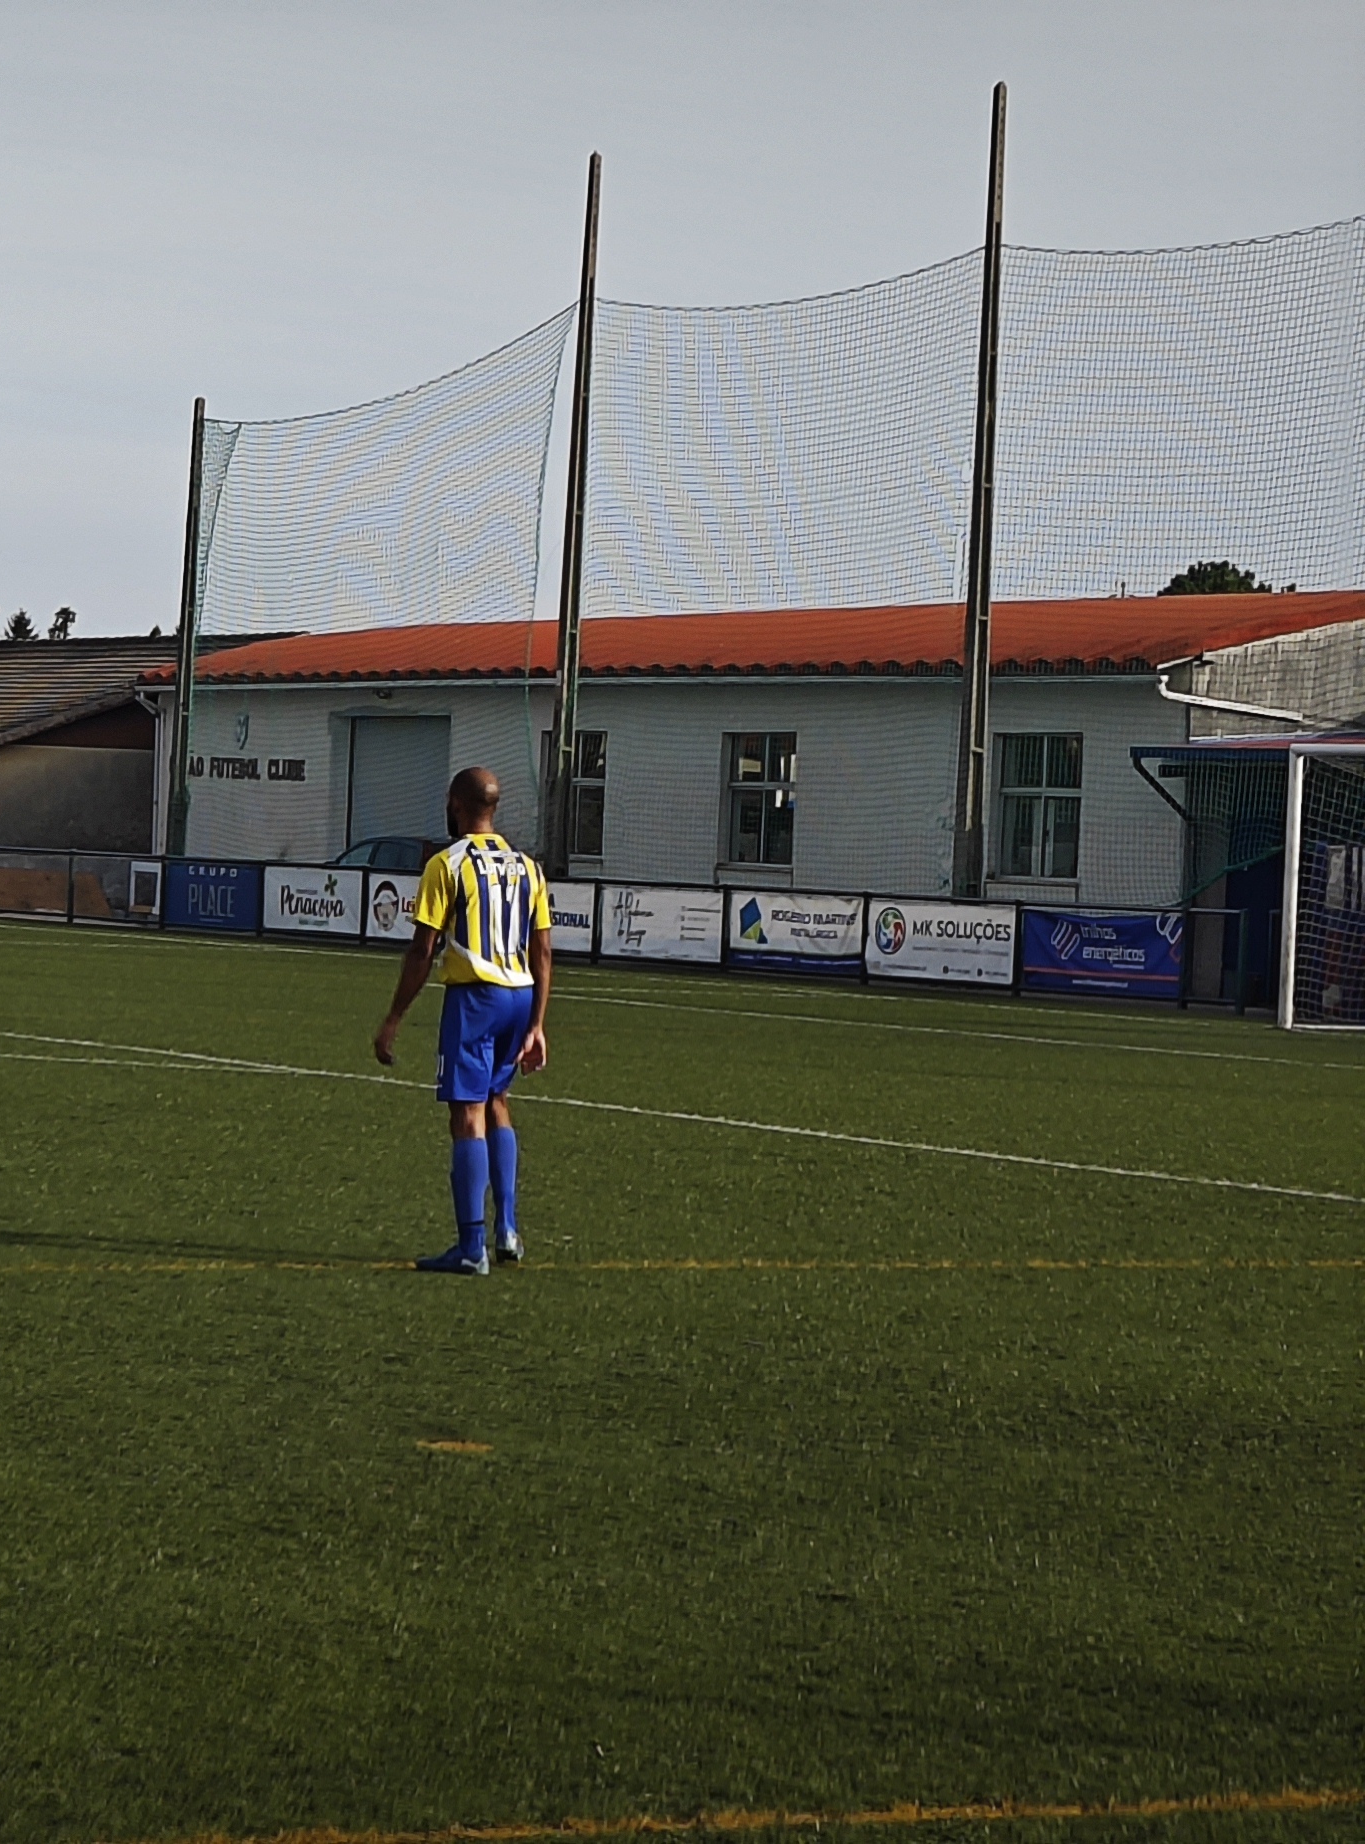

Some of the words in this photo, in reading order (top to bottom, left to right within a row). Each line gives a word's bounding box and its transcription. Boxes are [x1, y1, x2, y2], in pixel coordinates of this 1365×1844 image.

[188, 865, 237, 877] GRUPO
[188, 884, 236, 917] PLACE
[280, 885, 345, 917] Penacova
[912, 920, 933, 937] MK
[936, 918, 1011, 944] SOLUÇÕES
